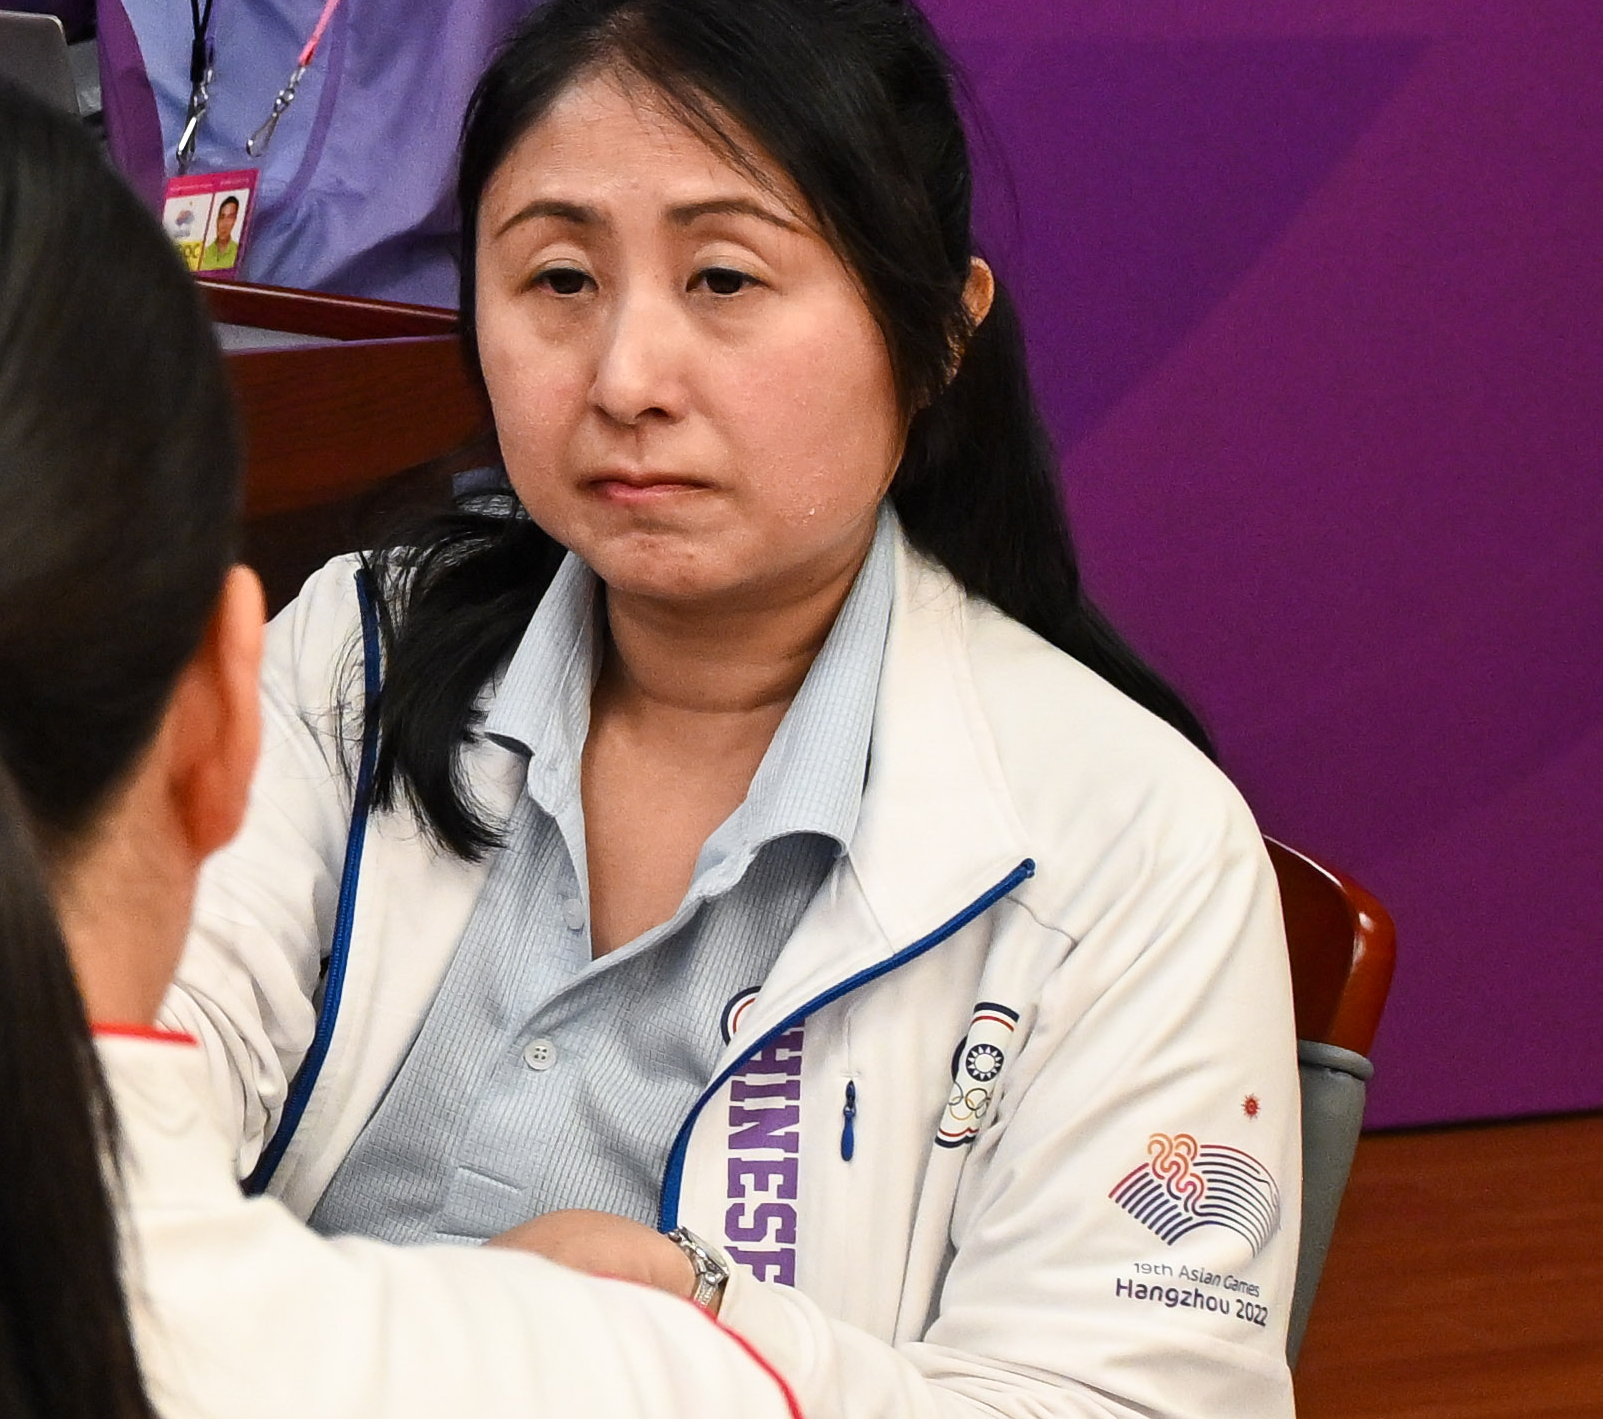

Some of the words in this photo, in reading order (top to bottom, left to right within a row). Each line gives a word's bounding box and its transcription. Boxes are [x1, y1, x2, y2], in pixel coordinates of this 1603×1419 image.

[724, 1017, 806, 1288] HINESE
[1115, 1277, 1231, 1315] Hangzhou
[1235, 1298, 1269, 1328] 2022
[1134, 1262, 1174, 1277] 19th
[1178, 1264, 1222, 1287] Asian
[1223, 1274, 1261, 1298] Games
